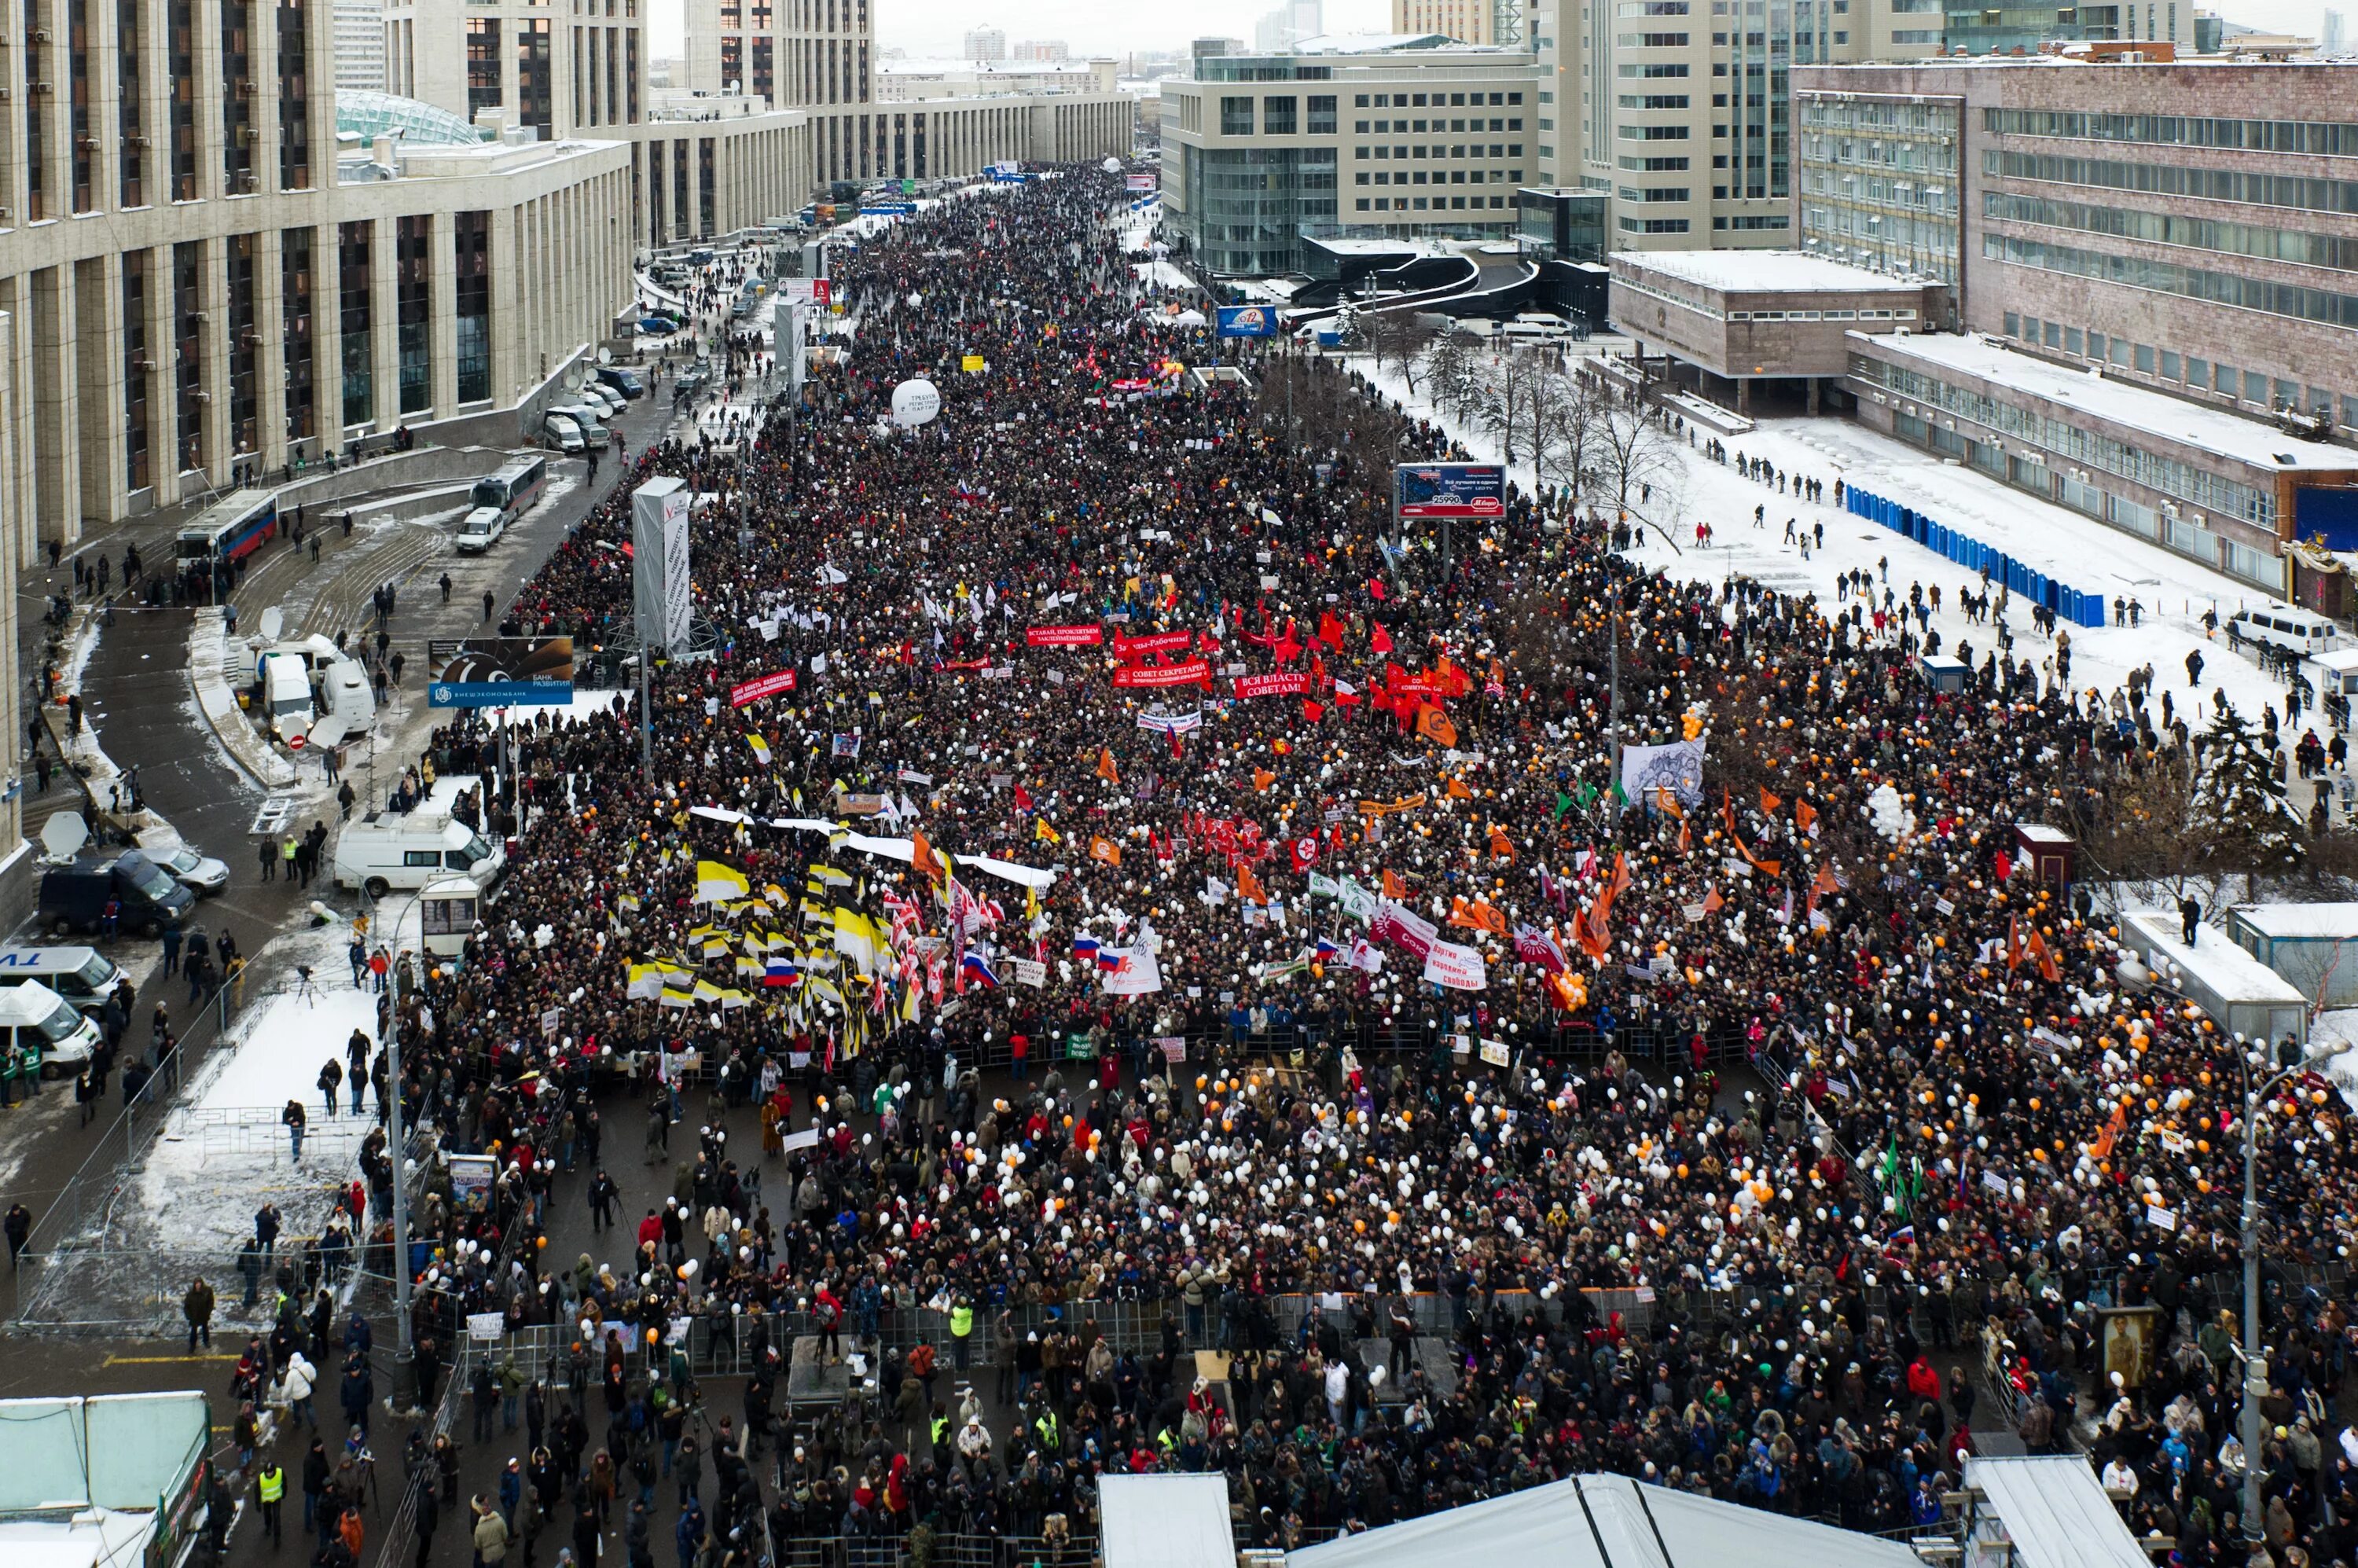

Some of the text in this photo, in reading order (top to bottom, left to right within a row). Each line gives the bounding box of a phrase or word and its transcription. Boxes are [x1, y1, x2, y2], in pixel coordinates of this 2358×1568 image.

[668, 524, 684, 563] ПРОВЕСТИ
[671, 548, 683, 575] НОВЫЕ
[668, 558, 687, 604] СВОБОДНЫЕ
[1117, 635, 1188, 652] Зады-Рабочим!
[1159, 663, 1206, 677] СЕКРЕТАРЕЙ
[1243, 674, 1306, 686] ВСЯ ВЛАСТЬ
[1247, 683, 1301, 696] СОВЕТАМ!
[1432, 943, 1457, 959] Партия
[0, 953, 42, 967] TV
